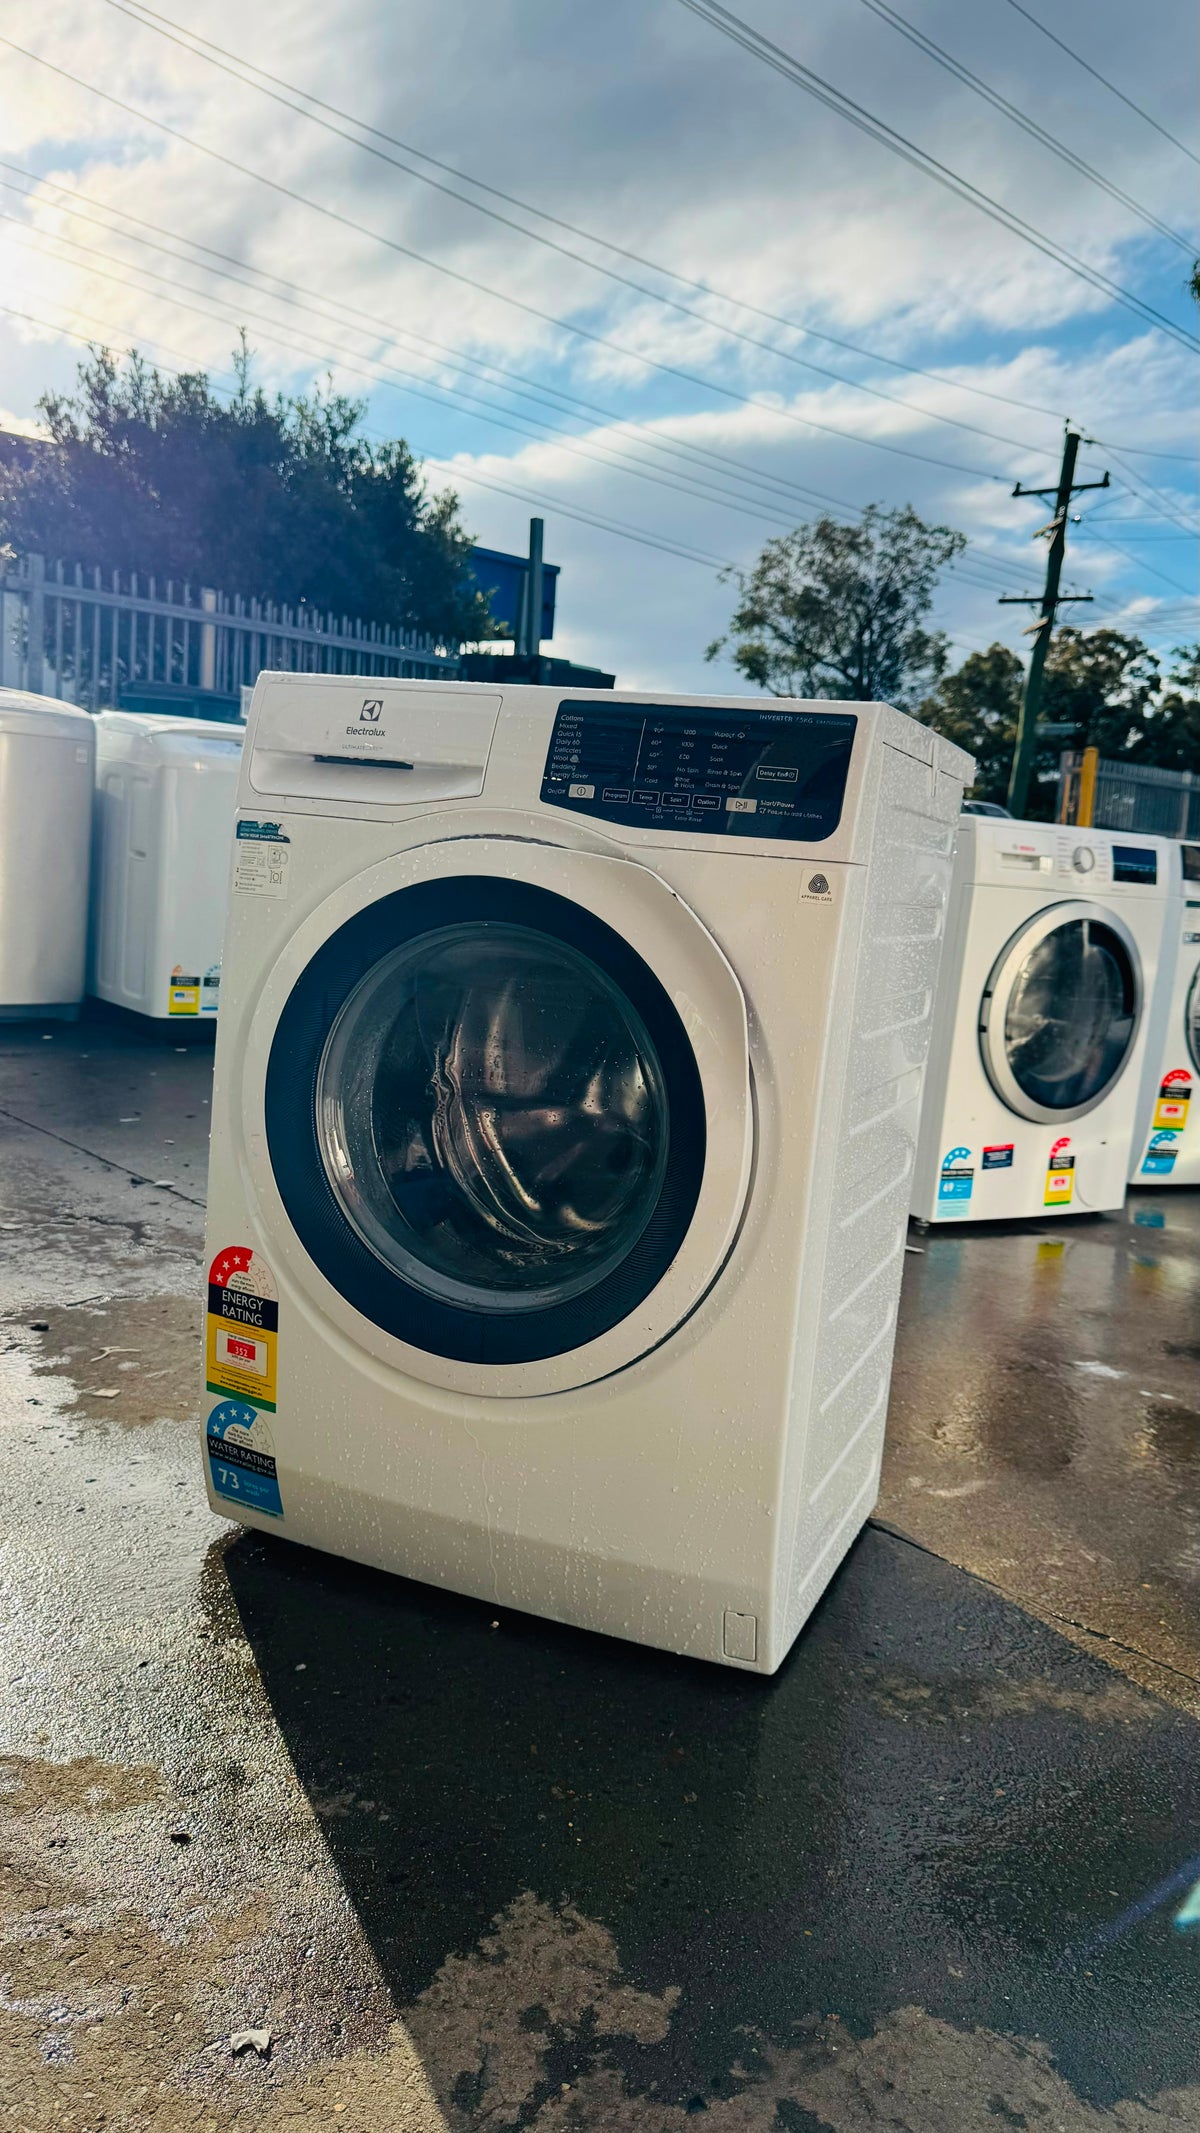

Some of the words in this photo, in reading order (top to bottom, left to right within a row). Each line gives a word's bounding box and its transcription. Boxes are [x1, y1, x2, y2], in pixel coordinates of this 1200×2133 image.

[561, 714, 584, 722] Cottons
[760, 714, 793, 722] INVERTER
[346, 726, 386, 737] Electrolux
[551, 763, 576, 771] Bedding
[550, 771, 570, 779] Energy
[222, 1290, 264, 1311] ENERGY
[222, 1304, 262, 1325] RATING
[235, 1346, 248, 1357] 352
[208, 1438, 239, 1457] WATER
[240, 1450, 274, 1469] RATING
[218, 1467, 239, 1489] 73
